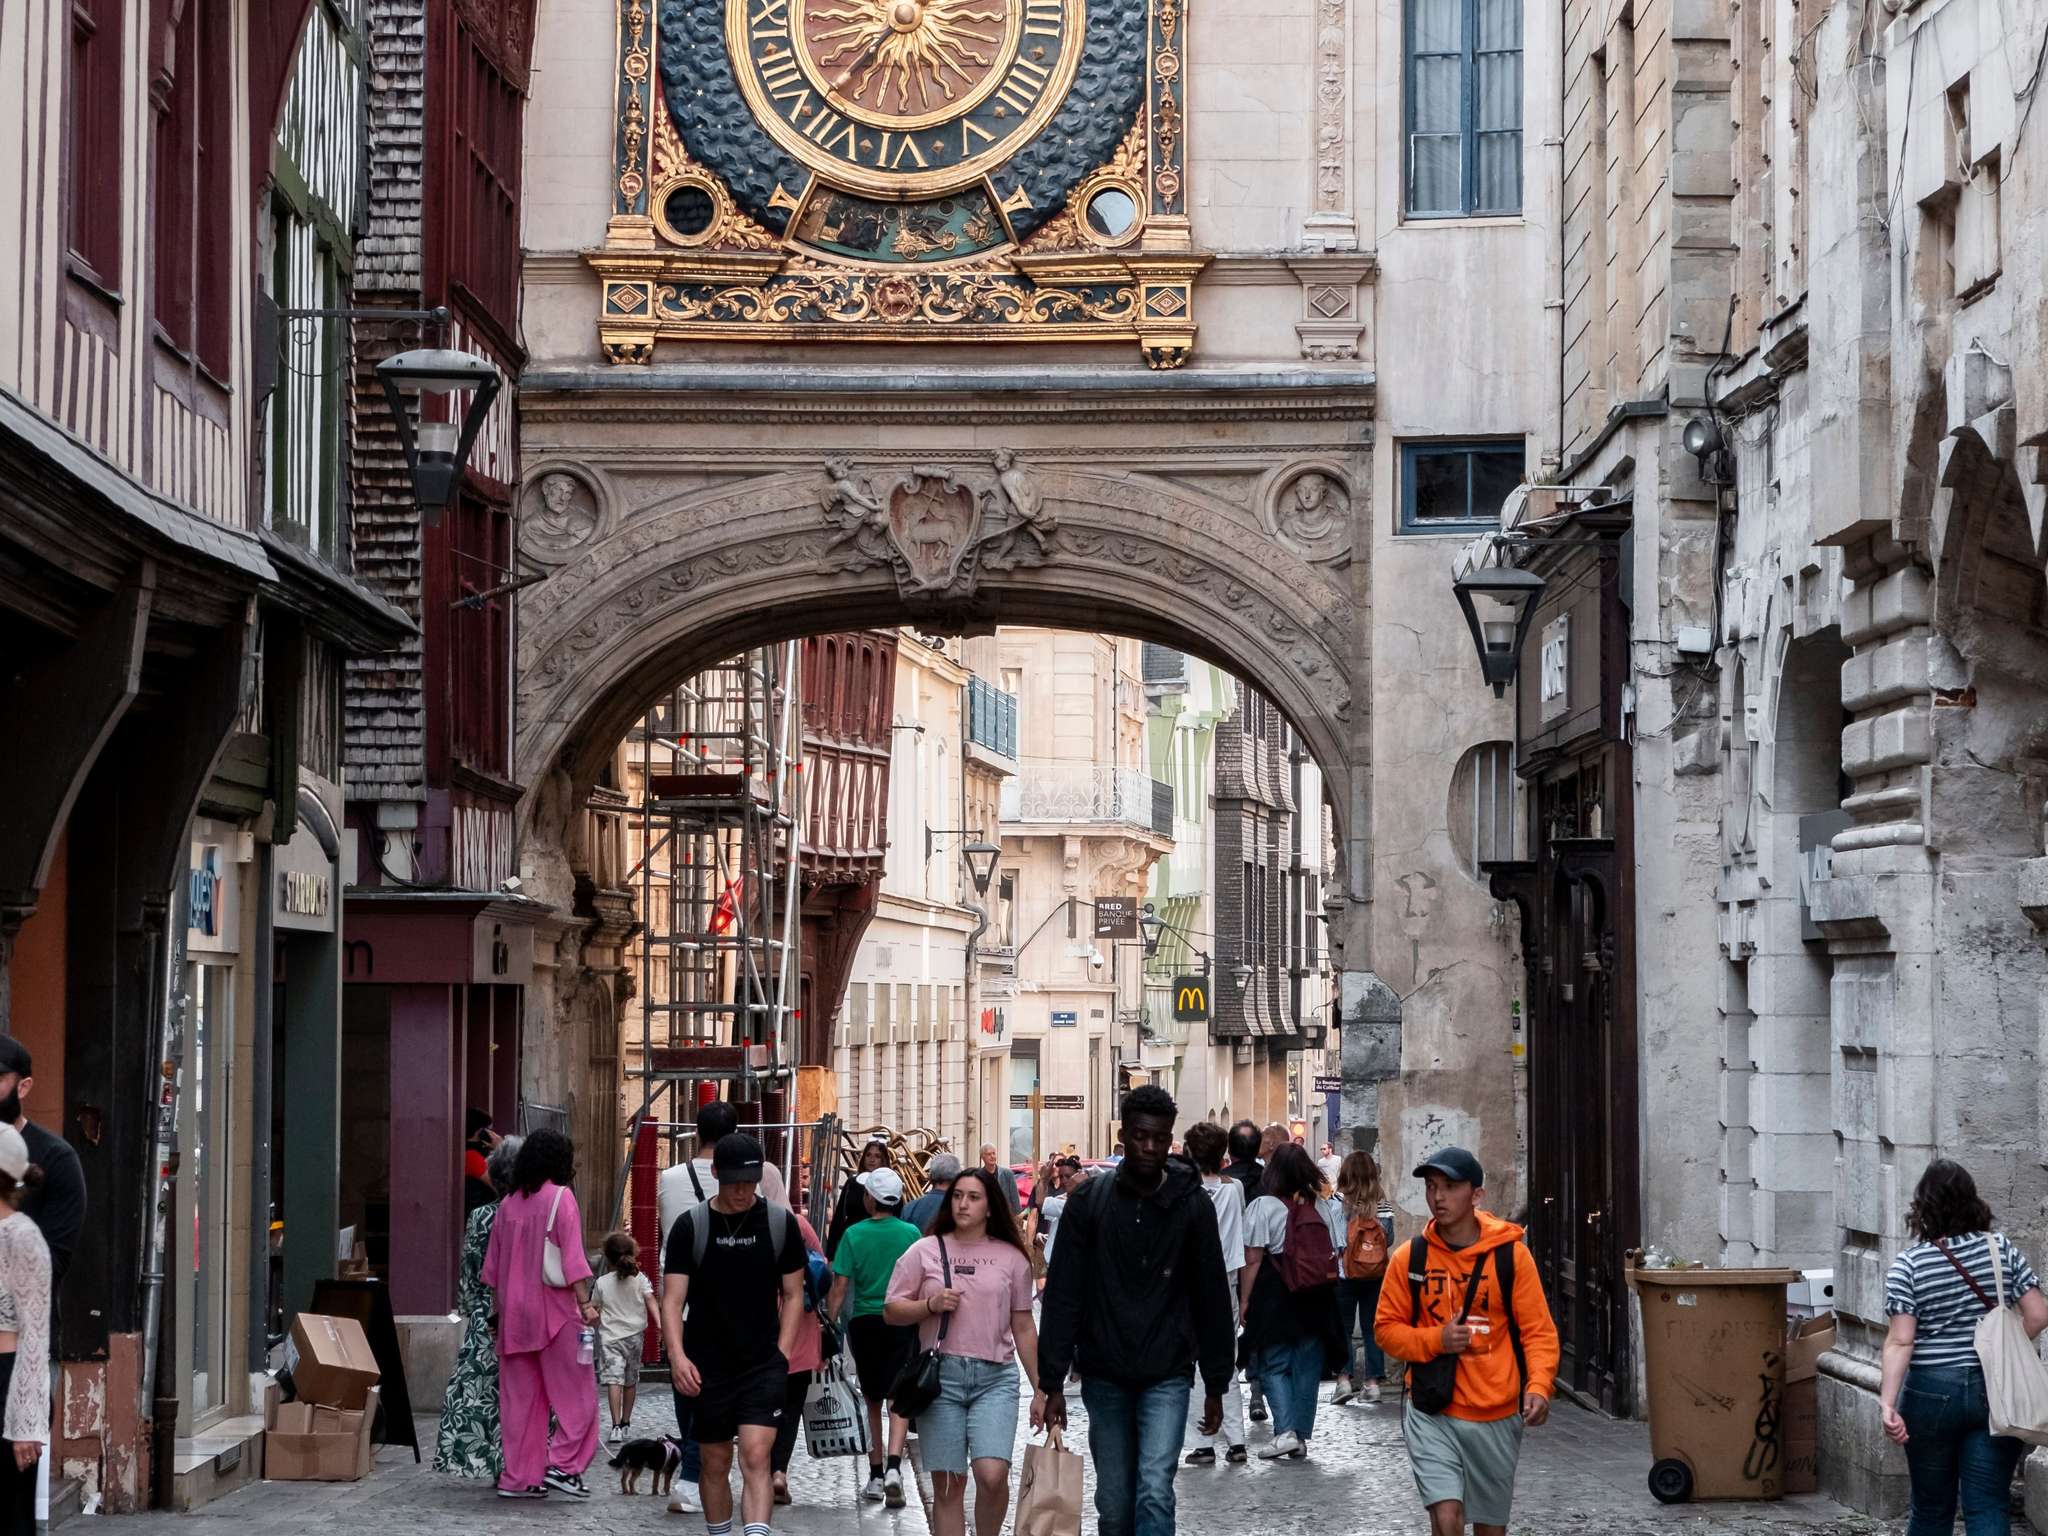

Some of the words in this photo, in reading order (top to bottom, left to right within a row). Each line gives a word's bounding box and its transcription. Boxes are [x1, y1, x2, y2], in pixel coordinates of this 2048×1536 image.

[757, 47, 810, 125] VIII
[995, 55, 1050, 116] IIII
[801, 105, 858, 162] VII
[876, 132, 929, 169] VI
[961, 118, 997, 157] V
[932, 1257, 998, 1266] SHO-NYC
